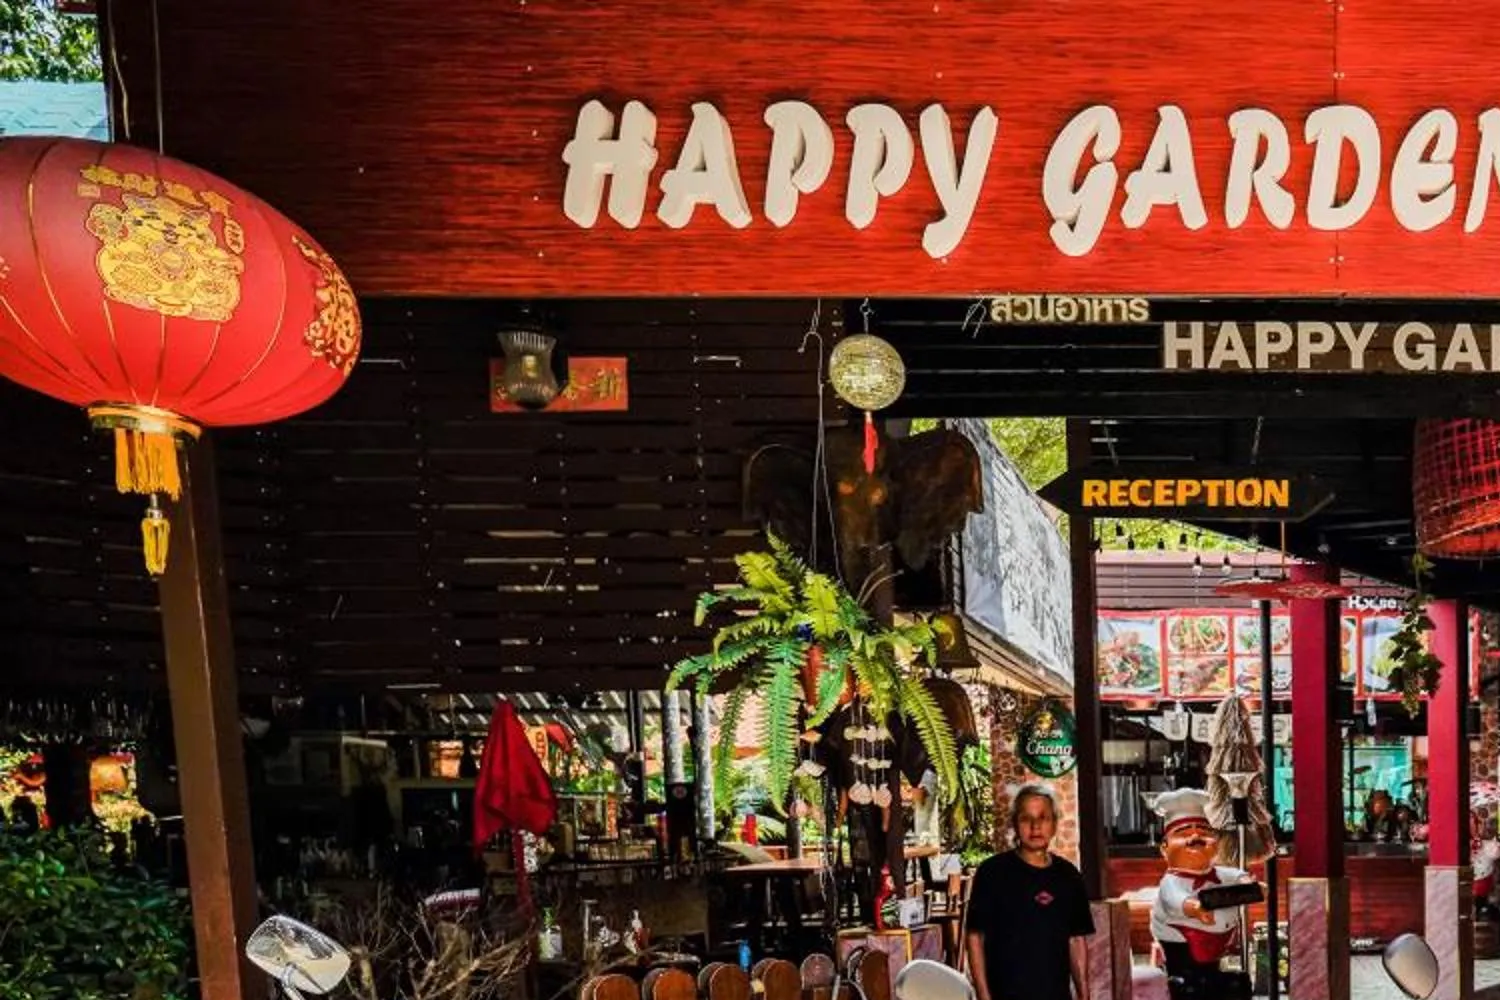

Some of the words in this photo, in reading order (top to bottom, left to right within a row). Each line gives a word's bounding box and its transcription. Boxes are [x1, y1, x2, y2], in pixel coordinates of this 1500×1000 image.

[562, 100, 999, 258] HAPPY
[1163, 320, 1379, 372] HAPPY
[1081, 478, 1290, 508] RECEPTION
